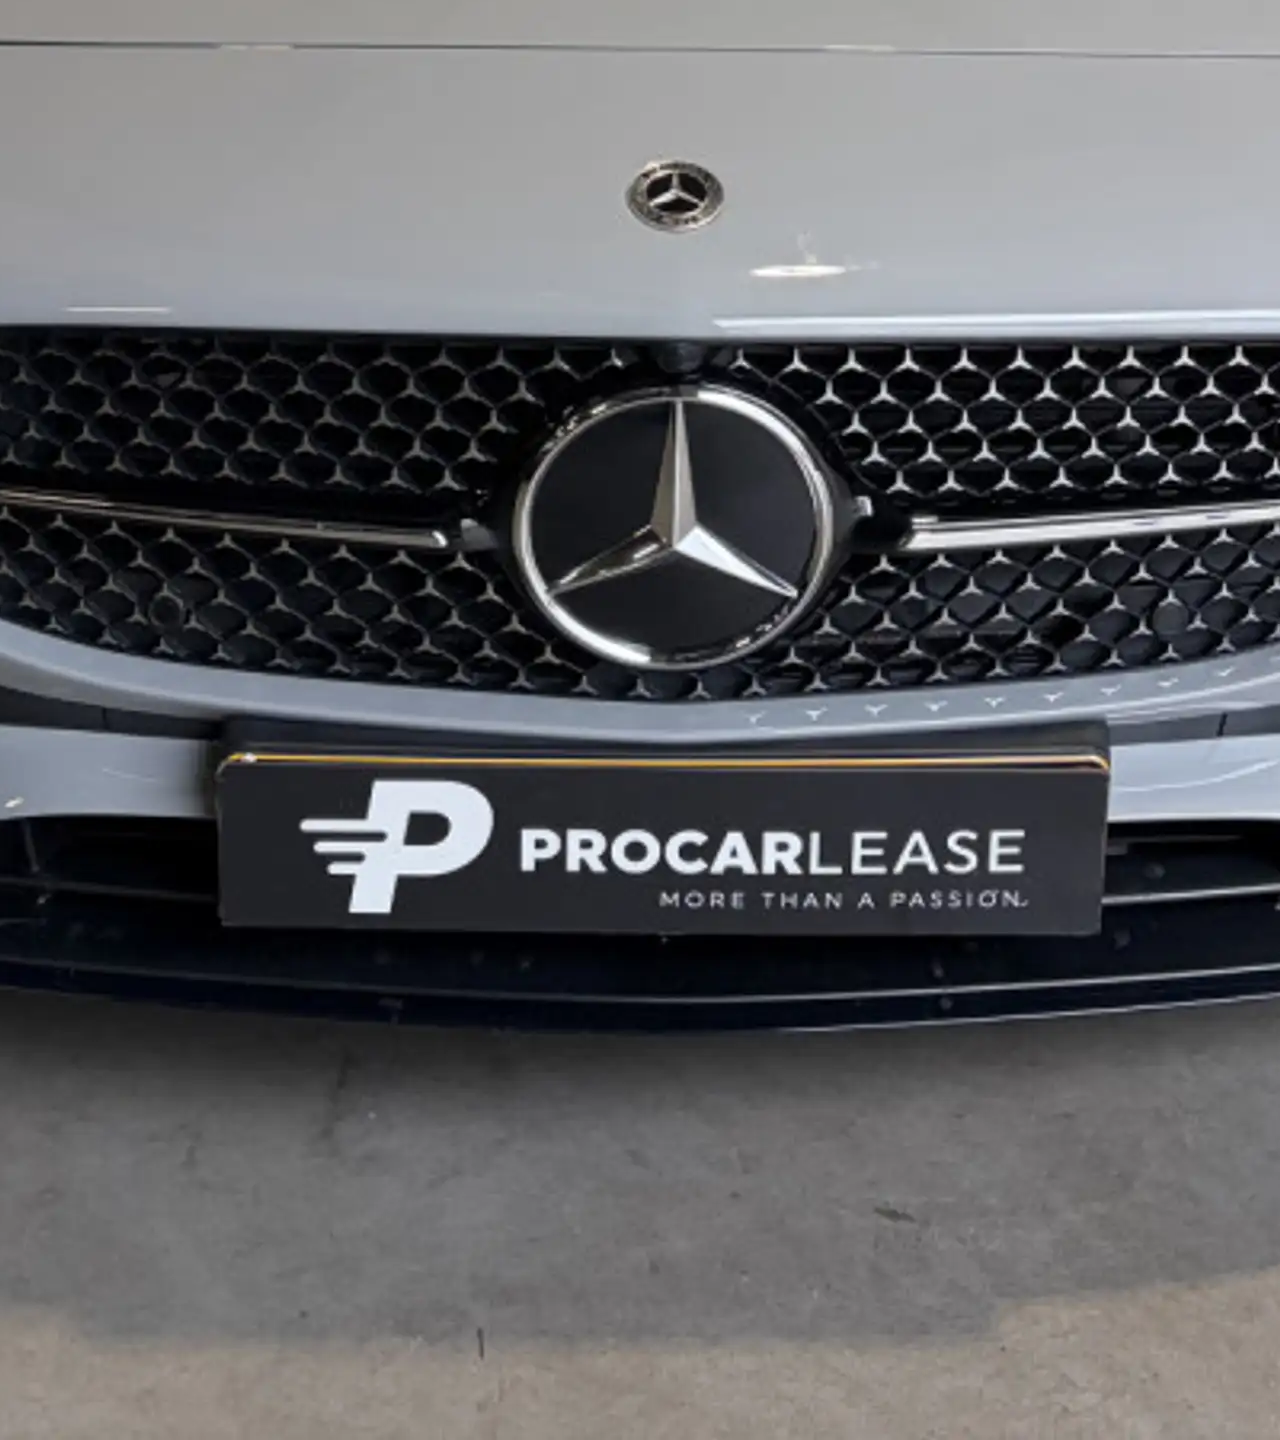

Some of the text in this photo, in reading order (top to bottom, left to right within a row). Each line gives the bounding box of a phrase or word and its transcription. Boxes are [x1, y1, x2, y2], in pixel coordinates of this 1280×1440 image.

[520, 827, 1026, 876] PROCARLEASE
[659, 890, 744, 909] MORE
[762, 891, 842, 909] THAN
[857, 891, 876, 909] A
